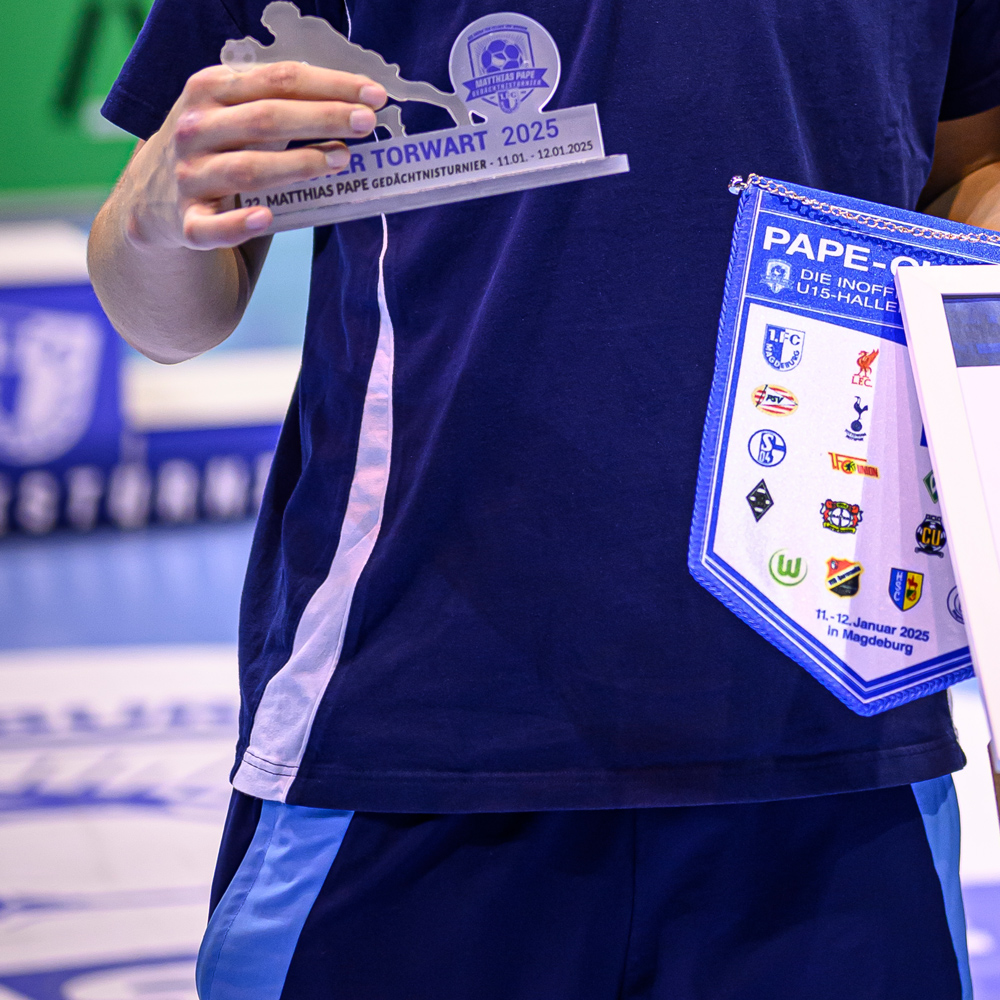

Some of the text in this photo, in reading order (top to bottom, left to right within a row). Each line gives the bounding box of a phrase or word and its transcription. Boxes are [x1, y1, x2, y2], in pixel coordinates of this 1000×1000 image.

[370, 130, 488, 169] TORWART
[501, 118, 559, 147] 2025
[266, 184, 334, 208] MATTHIAS
[336, 177, 370, 196] PAPE
[371, 159, 487, 190] GEDÄCHTNISTURNIER
[497, 152, 529, 168] 11.01.
[537, 140, 594, 160] 12.01.2025
[801, 268, 832, 286] DIE
[796, 281, 901, 314] U15-HALLE
[765, 394, 785, 404] PSV
[921, 526, 941, 546] CU
[827, 624, 914, 656] in Magdeburg
[853, 616, 897, 635] Januar
[899, 626, 930, 643] 2025
